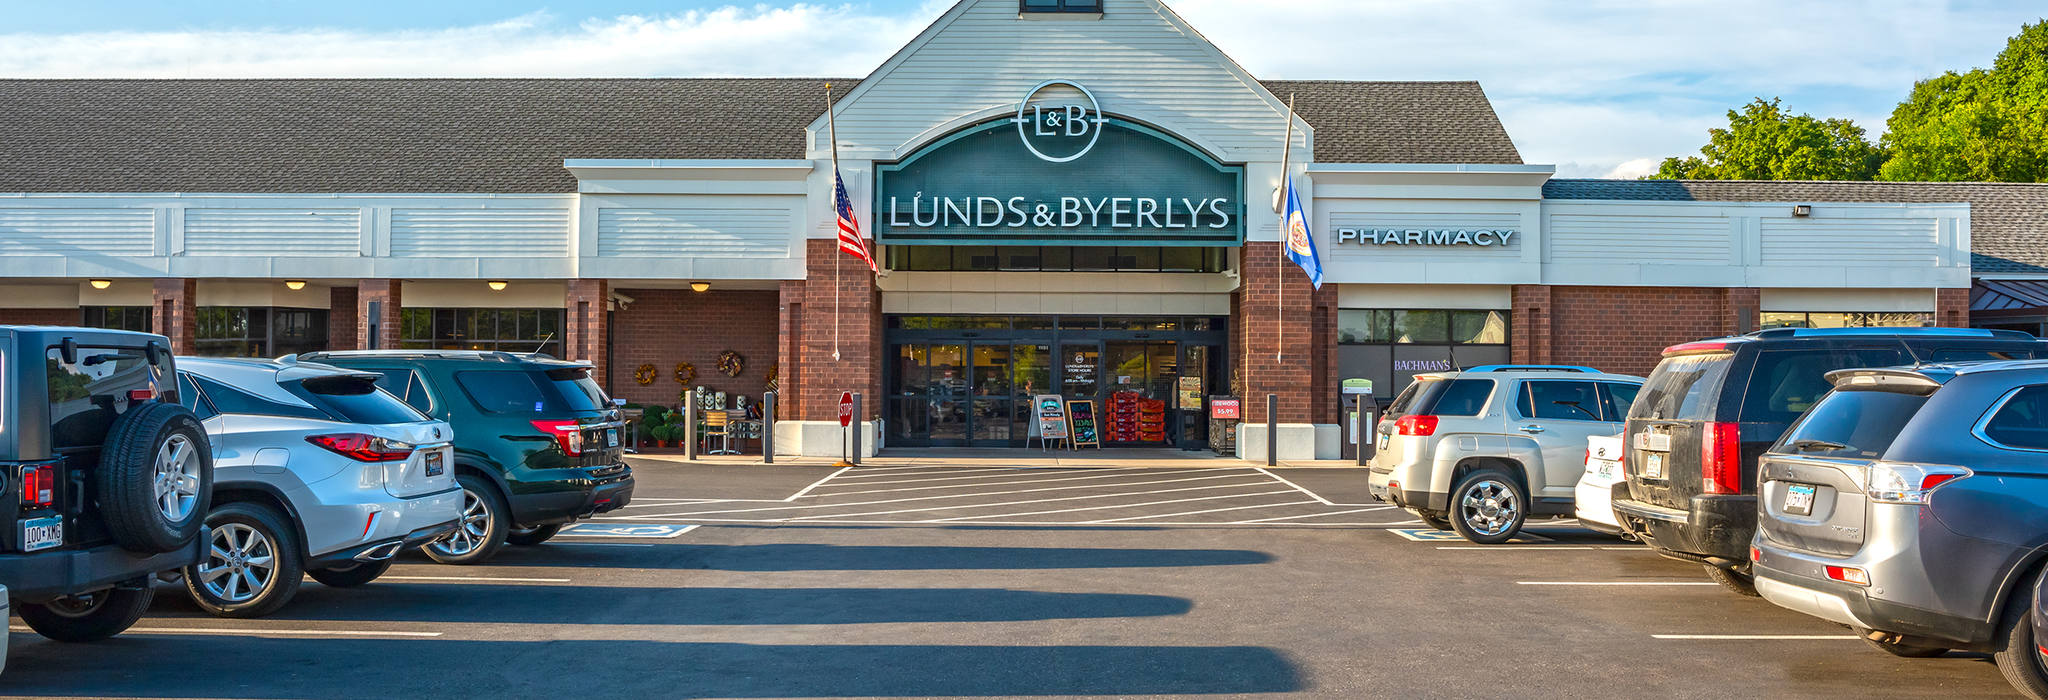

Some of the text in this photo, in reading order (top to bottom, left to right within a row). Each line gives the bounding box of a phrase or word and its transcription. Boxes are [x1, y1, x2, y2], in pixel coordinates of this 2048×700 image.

[1033, 104, 1089, 136] L&B
[1338, 228, 1514, 246] PHARMACY
[1394, 360, 1451, 371] BACHMAN'S
[840, 403, 853, 417] STOP
